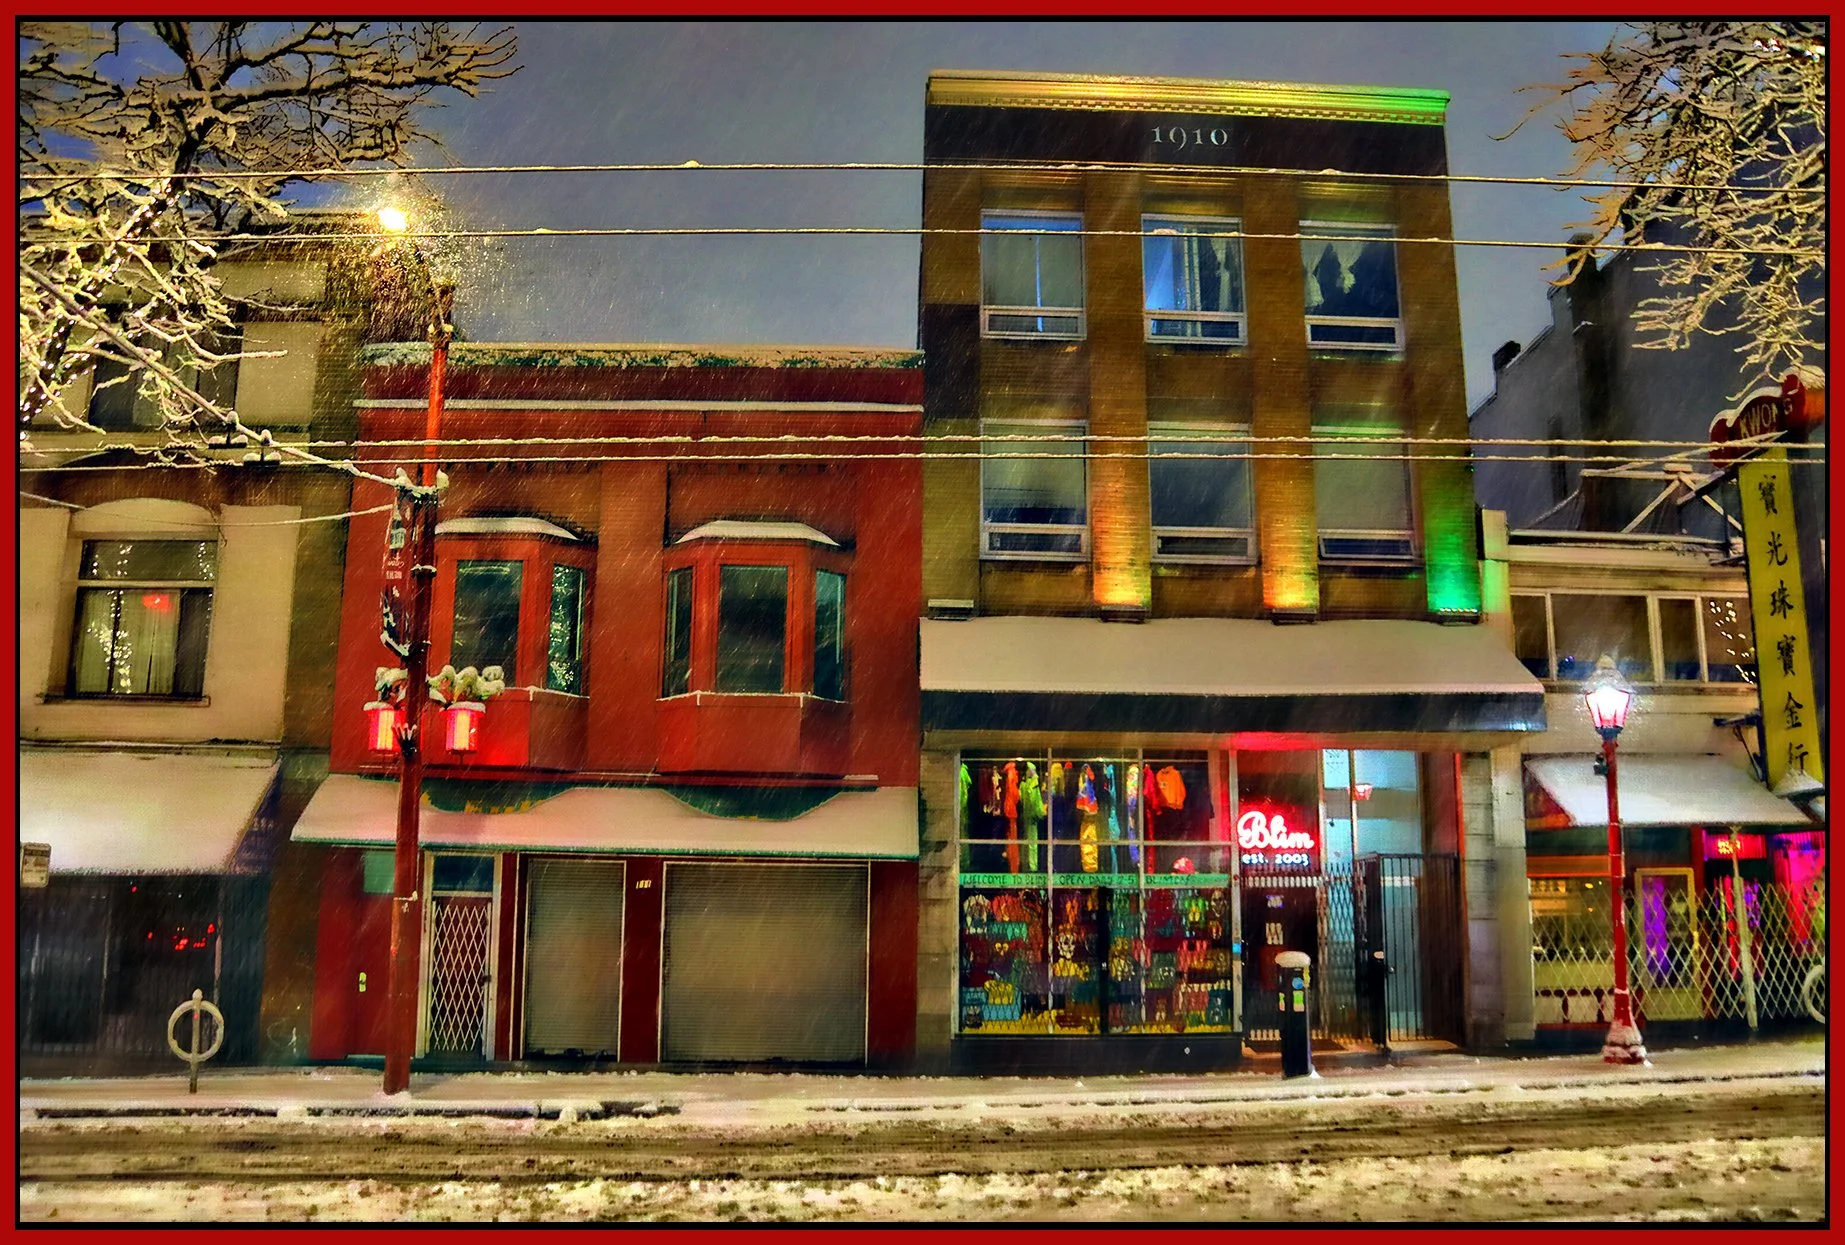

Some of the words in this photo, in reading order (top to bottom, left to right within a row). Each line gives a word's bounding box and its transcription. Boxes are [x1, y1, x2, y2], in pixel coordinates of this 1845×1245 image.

[1151, 126, 1228, 151] 1910
[1237, 811, 1315, 849] Blim
[1242, 852, 1268, 864] est.
[1275, 853, 1309, 866] 2003
[963, 874, 1006, 885] WELCOME
[1013, 874, 1023, 885] TO
[1059, 874, 1085, 885] OPEN
